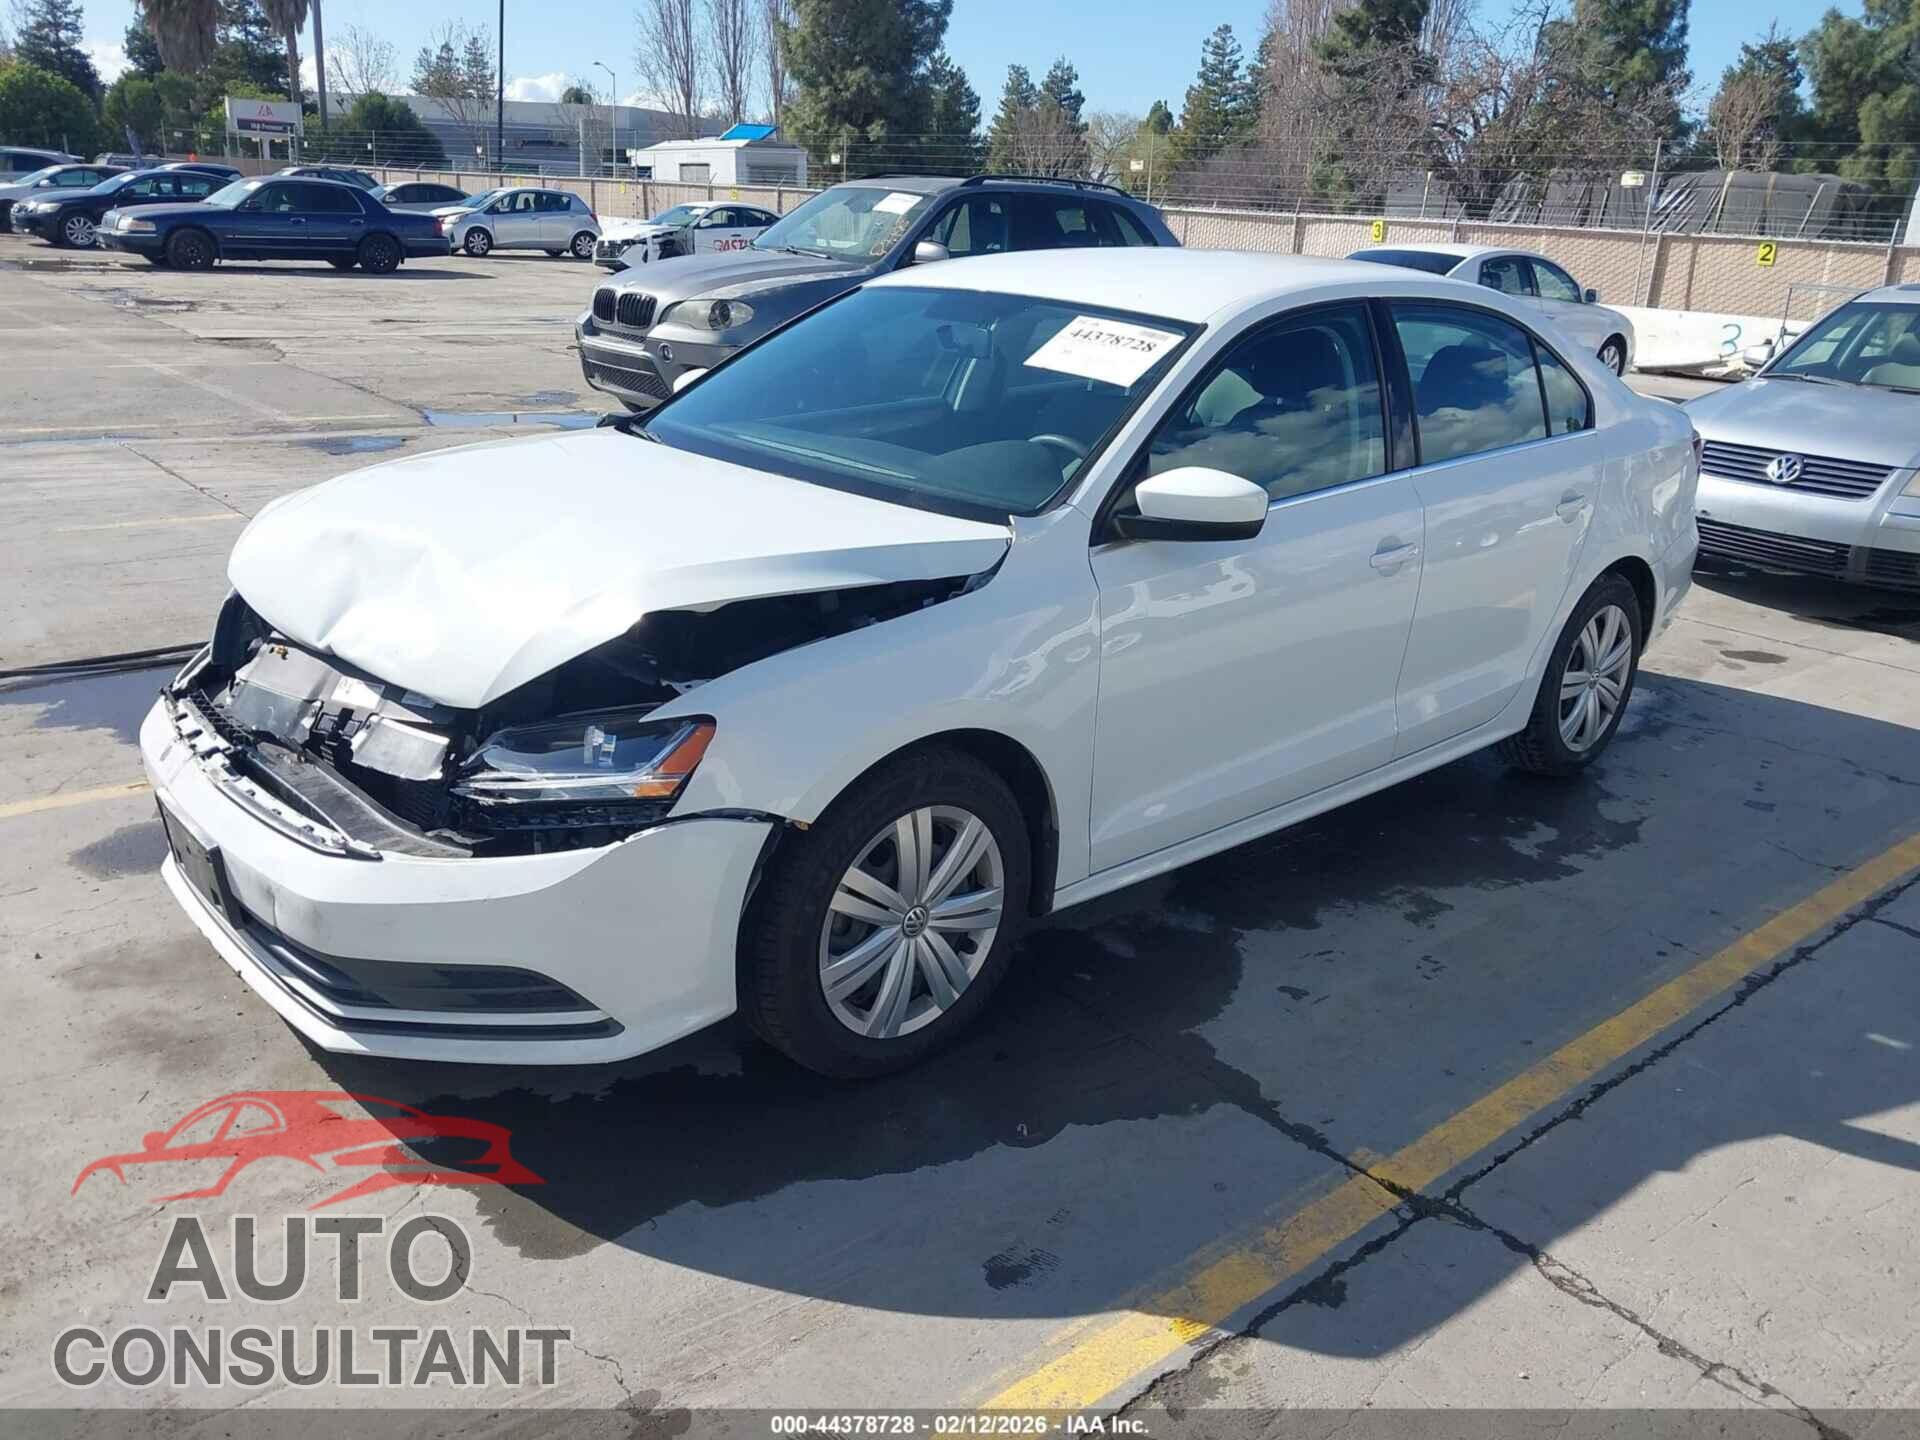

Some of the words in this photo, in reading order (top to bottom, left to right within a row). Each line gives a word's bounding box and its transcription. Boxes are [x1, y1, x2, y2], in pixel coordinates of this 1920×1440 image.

[1759, 243, 1774, 262] 2
[1070, 328, 1157, 352] 44378728
[1719, 323, 1742, 359] 3
